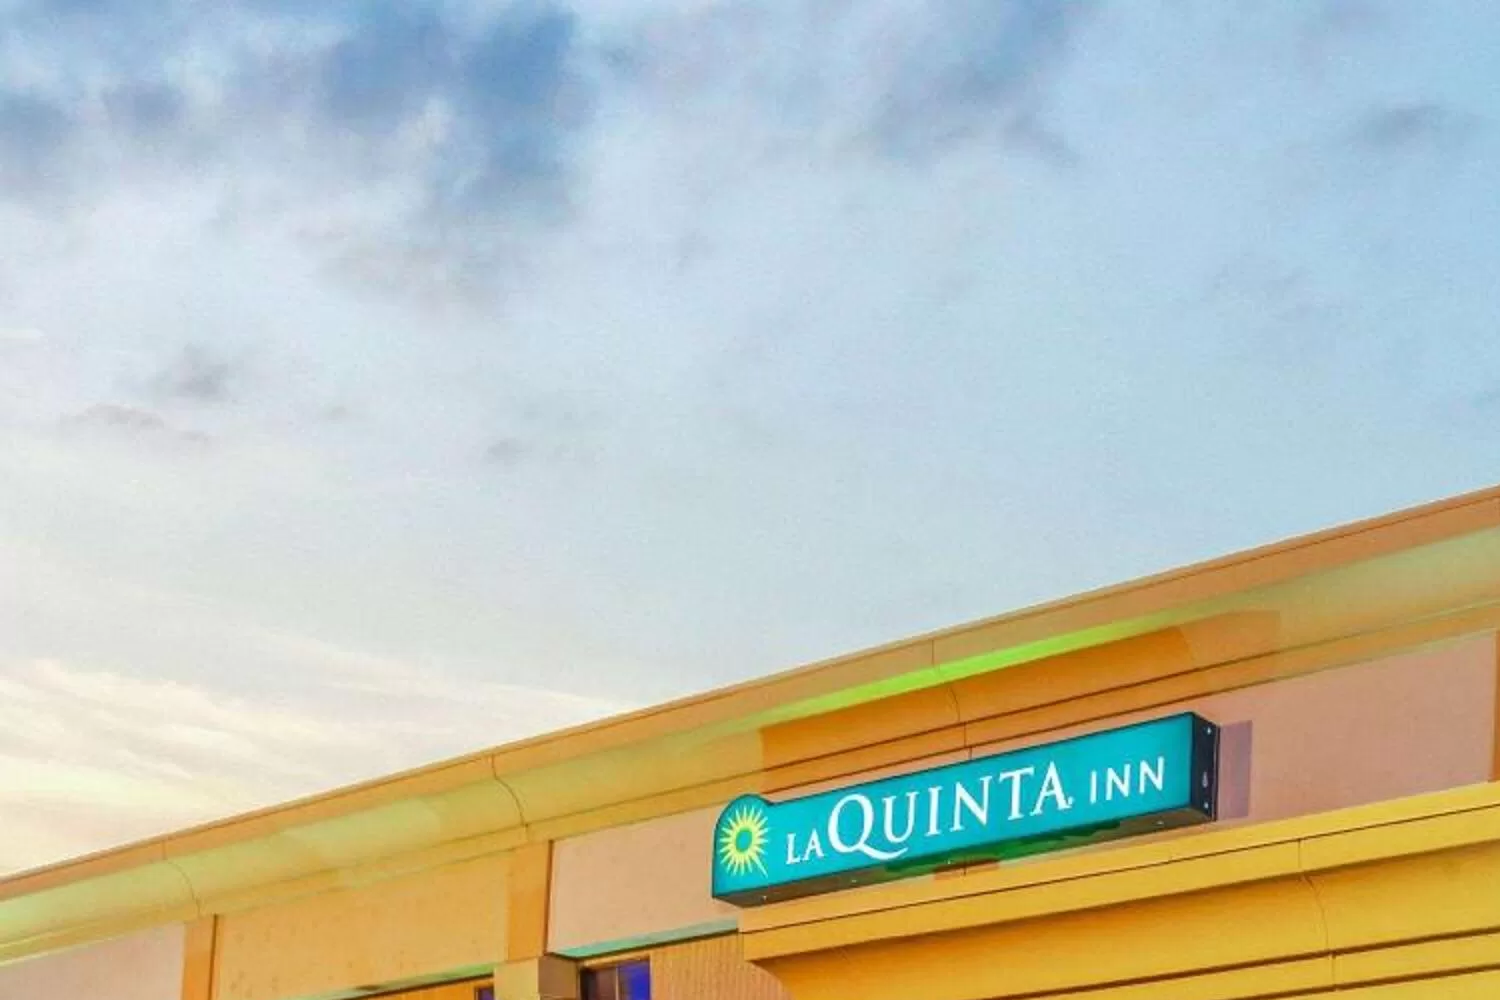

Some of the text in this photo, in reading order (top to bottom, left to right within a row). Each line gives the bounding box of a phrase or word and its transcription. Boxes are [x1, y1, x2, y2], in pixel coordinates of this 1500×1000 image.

[785, 755, 1165, 865] LA QUINTA INN
